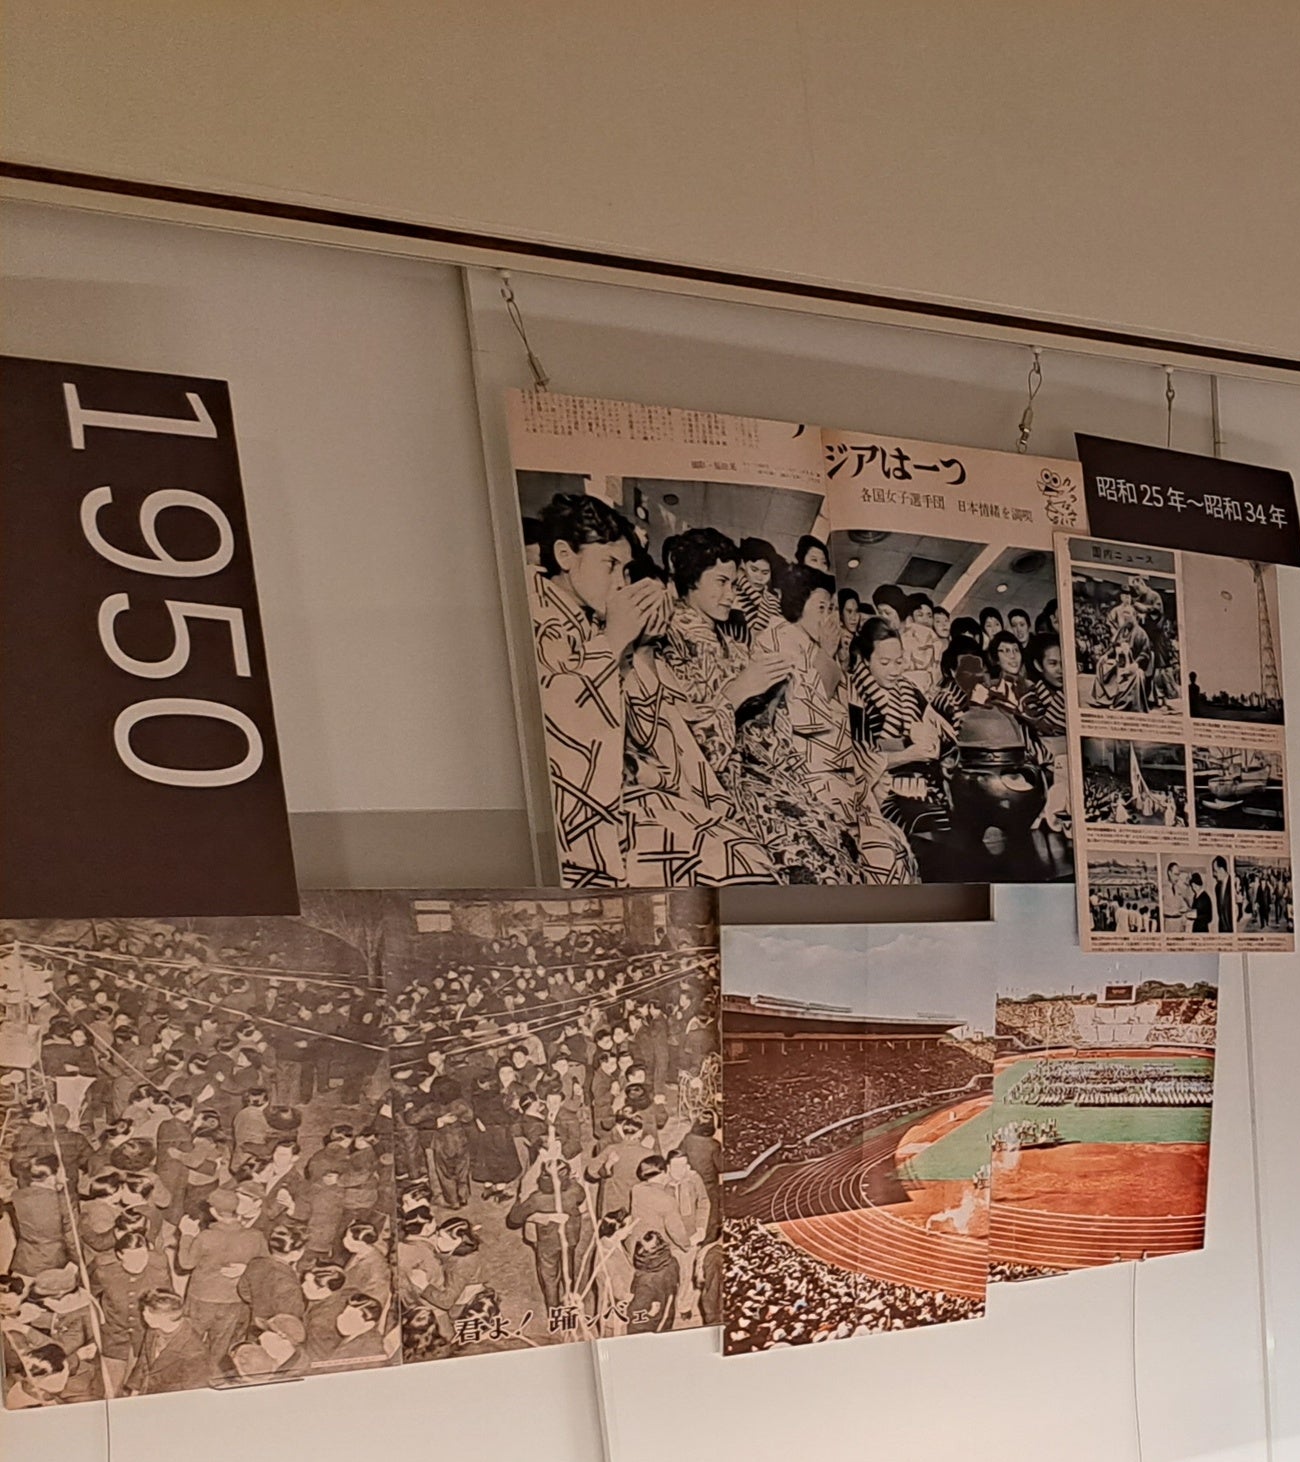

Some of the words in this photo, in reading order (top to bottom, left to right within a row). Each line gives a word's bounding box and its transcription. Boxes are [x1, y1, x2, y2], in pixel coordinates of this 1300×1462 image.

[861, 487, 946, 510] 各国女子選手団
[1091, 545, 1155, 565] 国内ニュース
[62, 382, 264, 788] 1950
